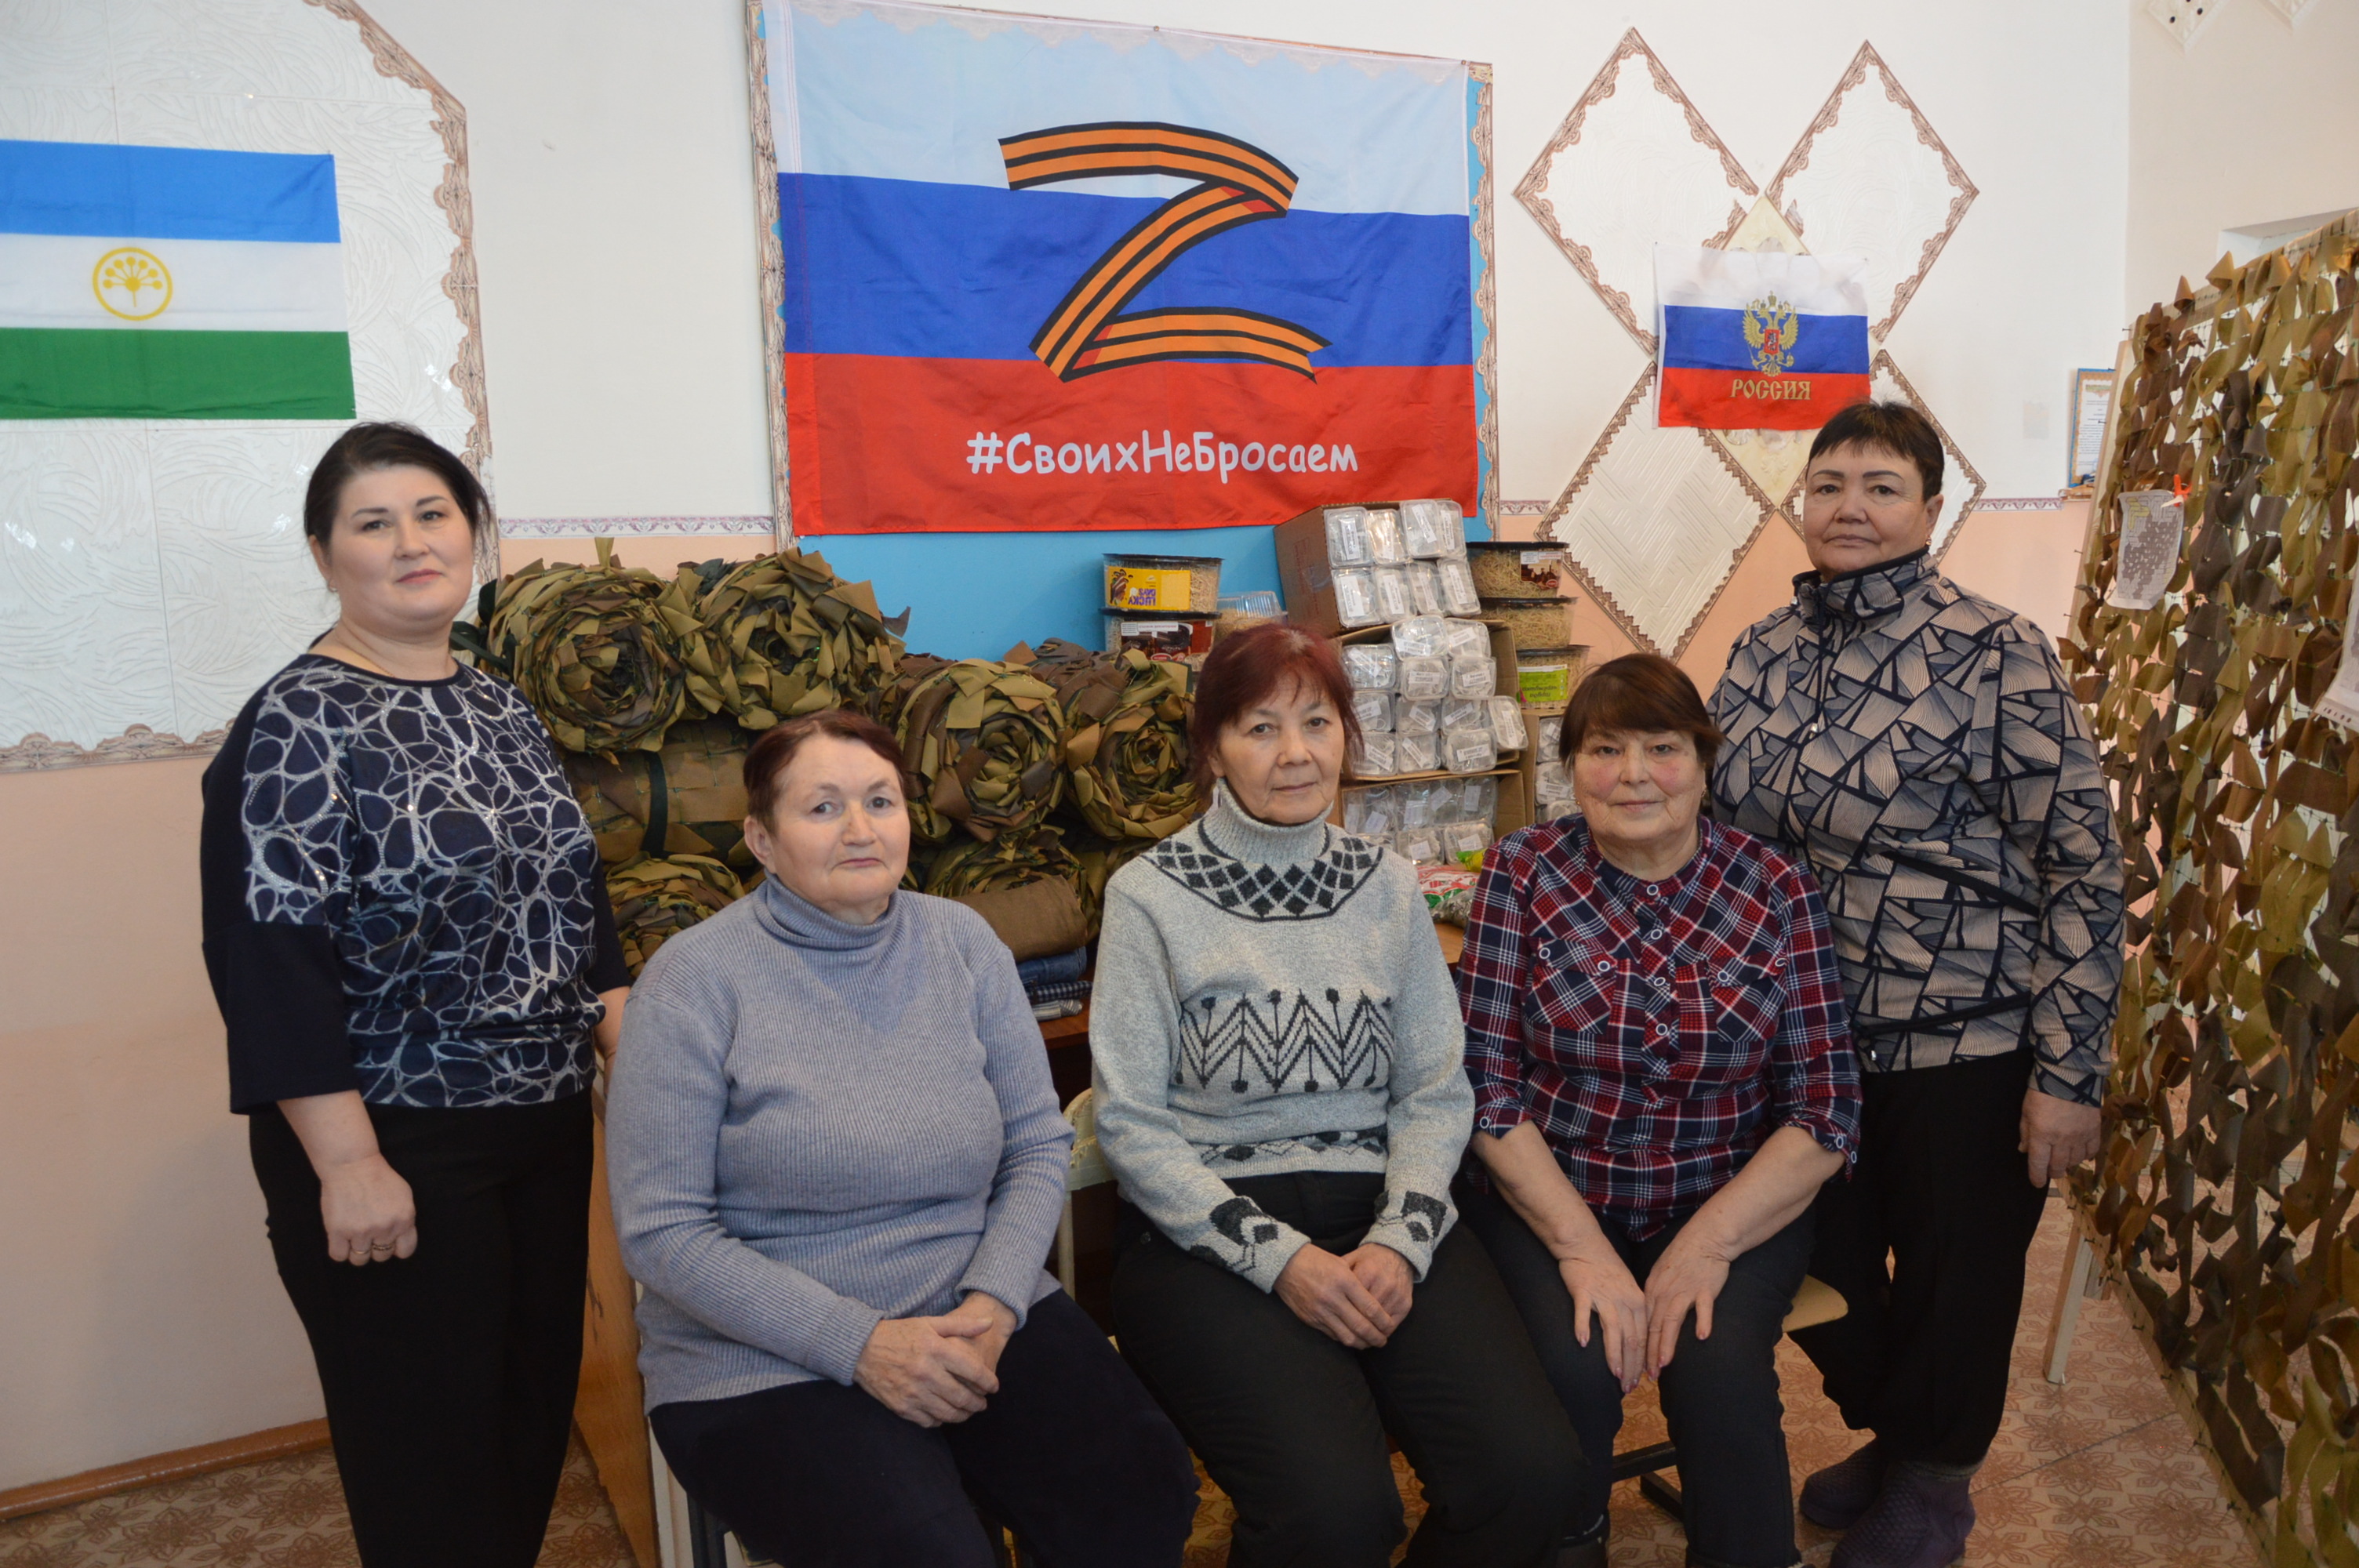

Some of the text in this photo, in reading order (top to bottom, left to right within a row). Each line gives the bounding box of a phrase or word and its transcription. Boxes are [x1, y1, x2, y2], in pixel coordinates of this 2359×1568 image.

[998, 122, 1333, 385] Z
[1729, 379, 1811, 400] РОССИЯ
[966, 429, 1358, 484] #СвоихНеБросаем
[1129, 596, 1156, 606] LUCKY
